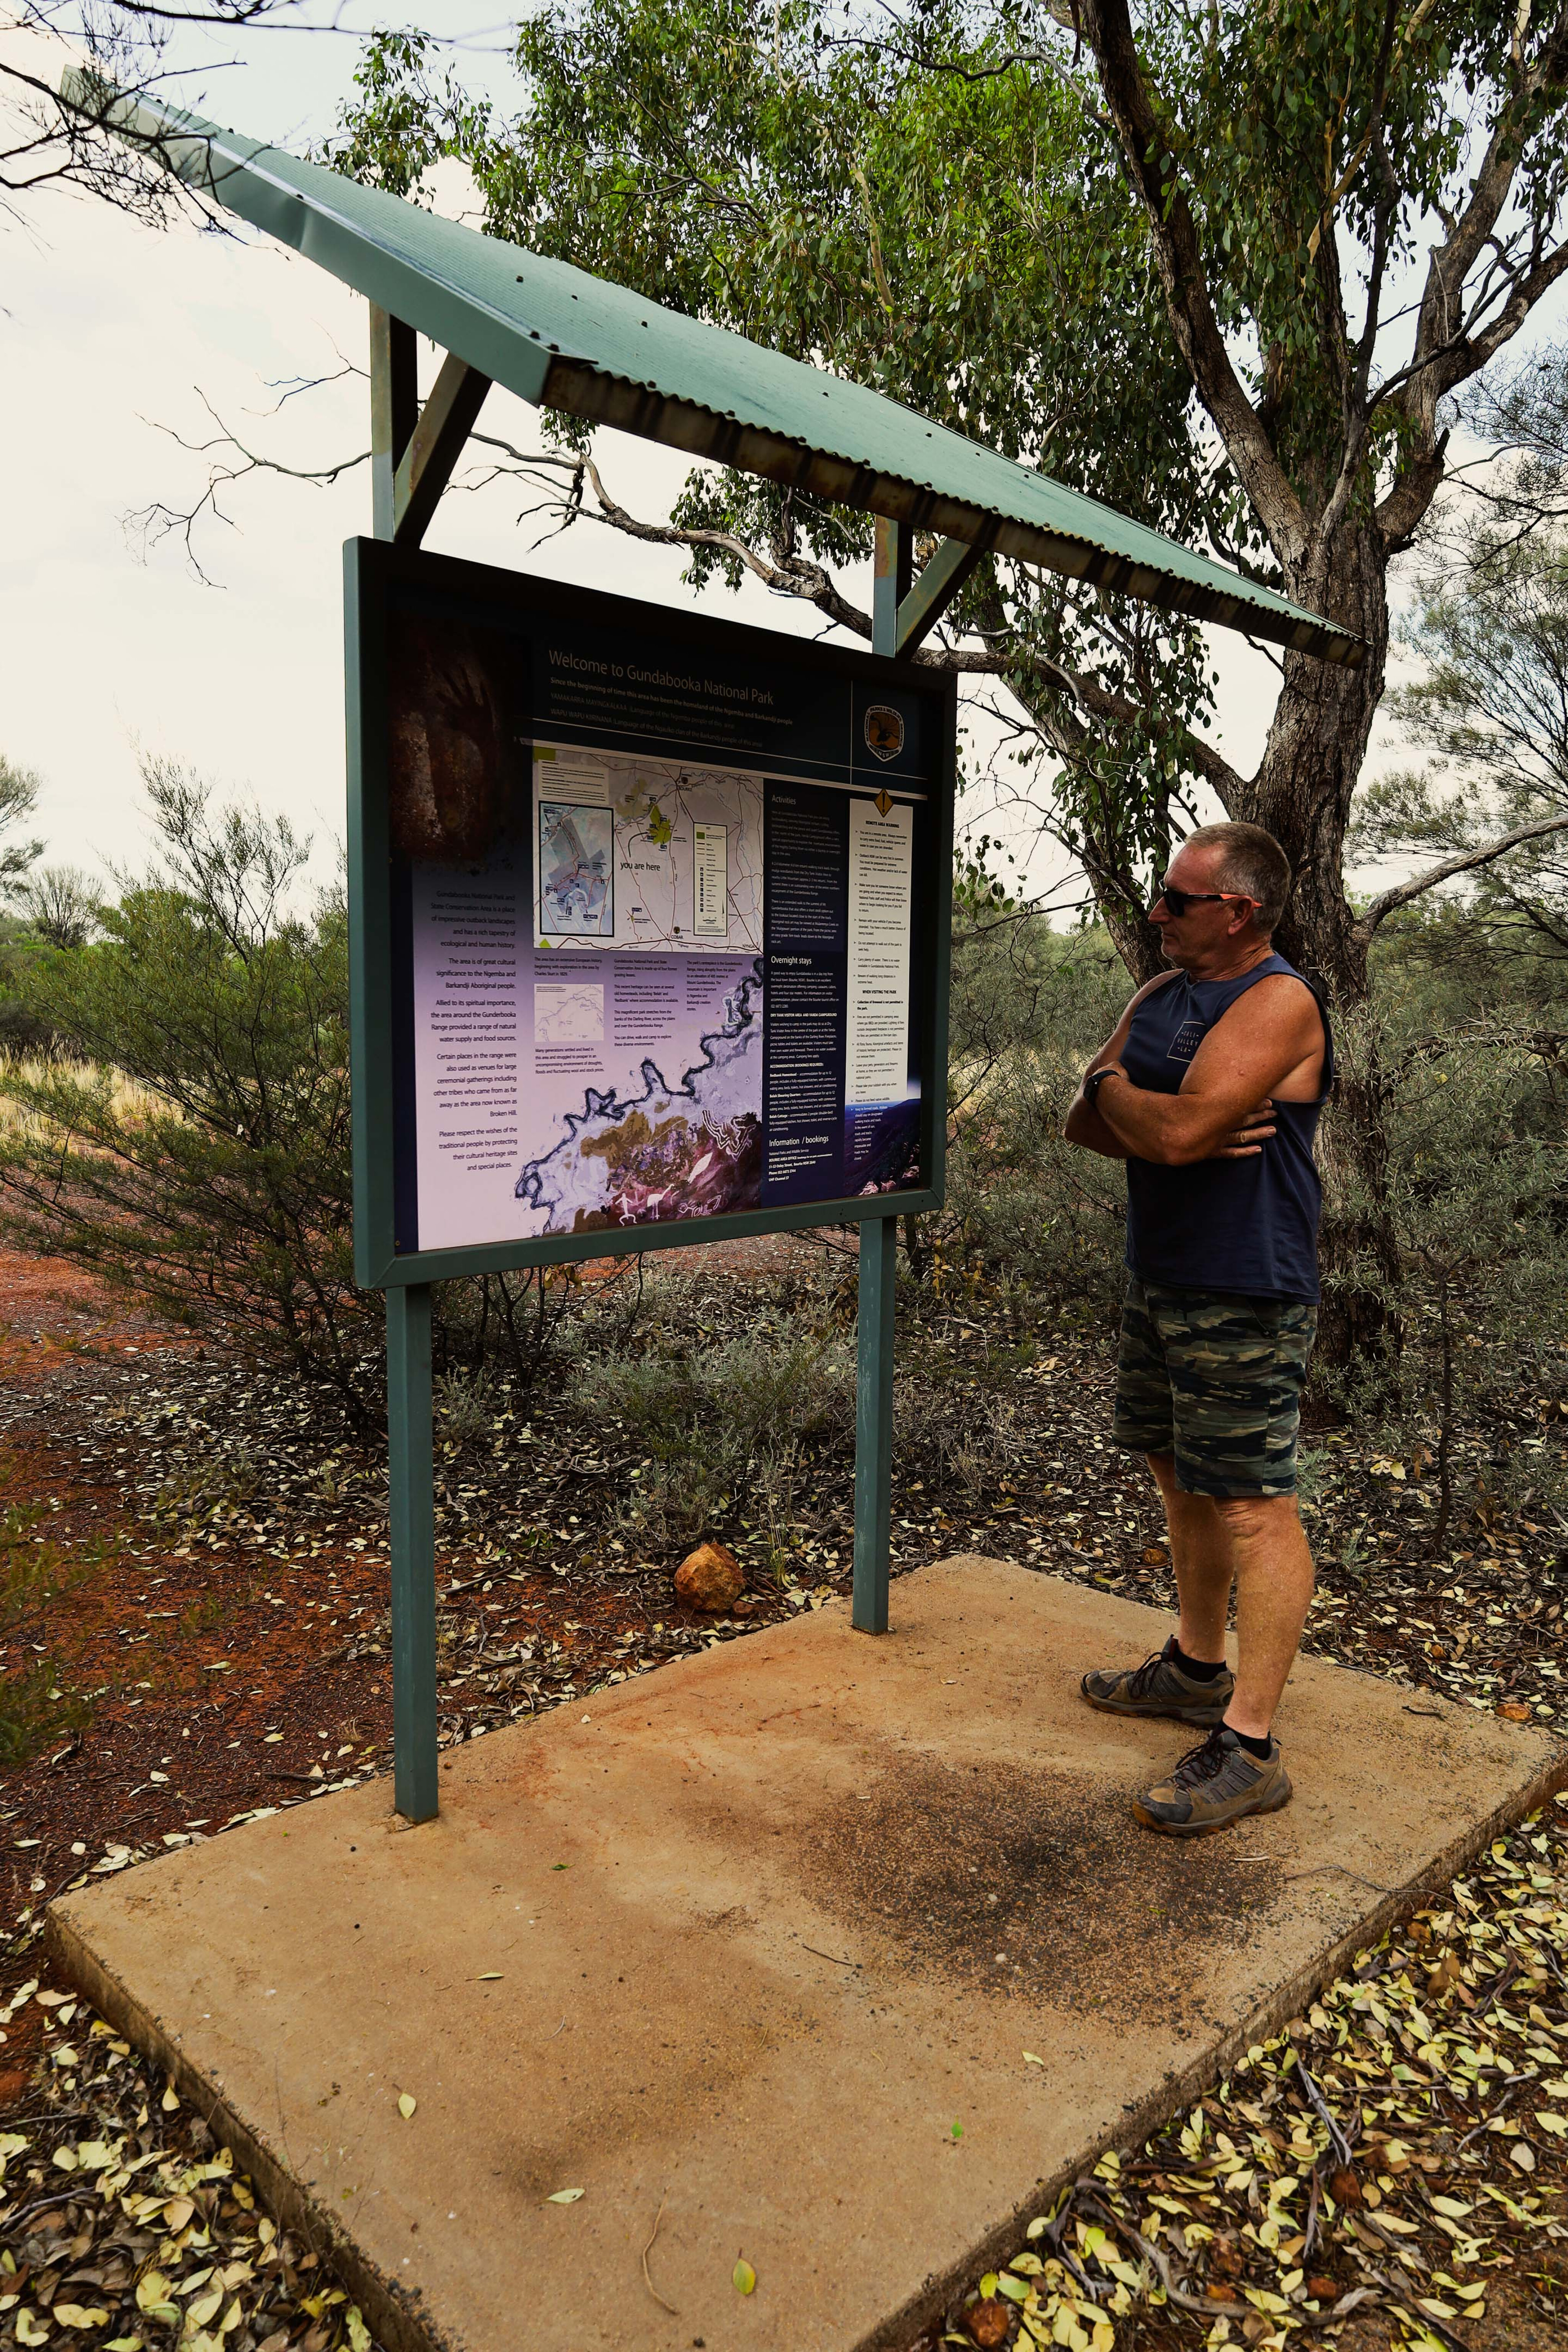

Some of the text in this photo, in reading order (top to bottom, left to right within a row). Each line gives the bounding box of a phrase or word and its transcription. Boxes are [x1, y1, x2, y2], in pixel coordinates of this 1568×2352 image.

[549, 650, 773, 705] Welcome to Gundabooka National Park
[550, 677, 566, 685] Since
[577, 681, 606, 694] beginning
[683, 700, 708, 710] homeland
[777, 717, 792, 726] people
[772, 795, 795, 804] Activities
[620, 862, 632, 870] you
[646, 862, 660, 871] here
[771, 956, 797, 965] Overnight
[769, 1138, 799, 1146] Information
